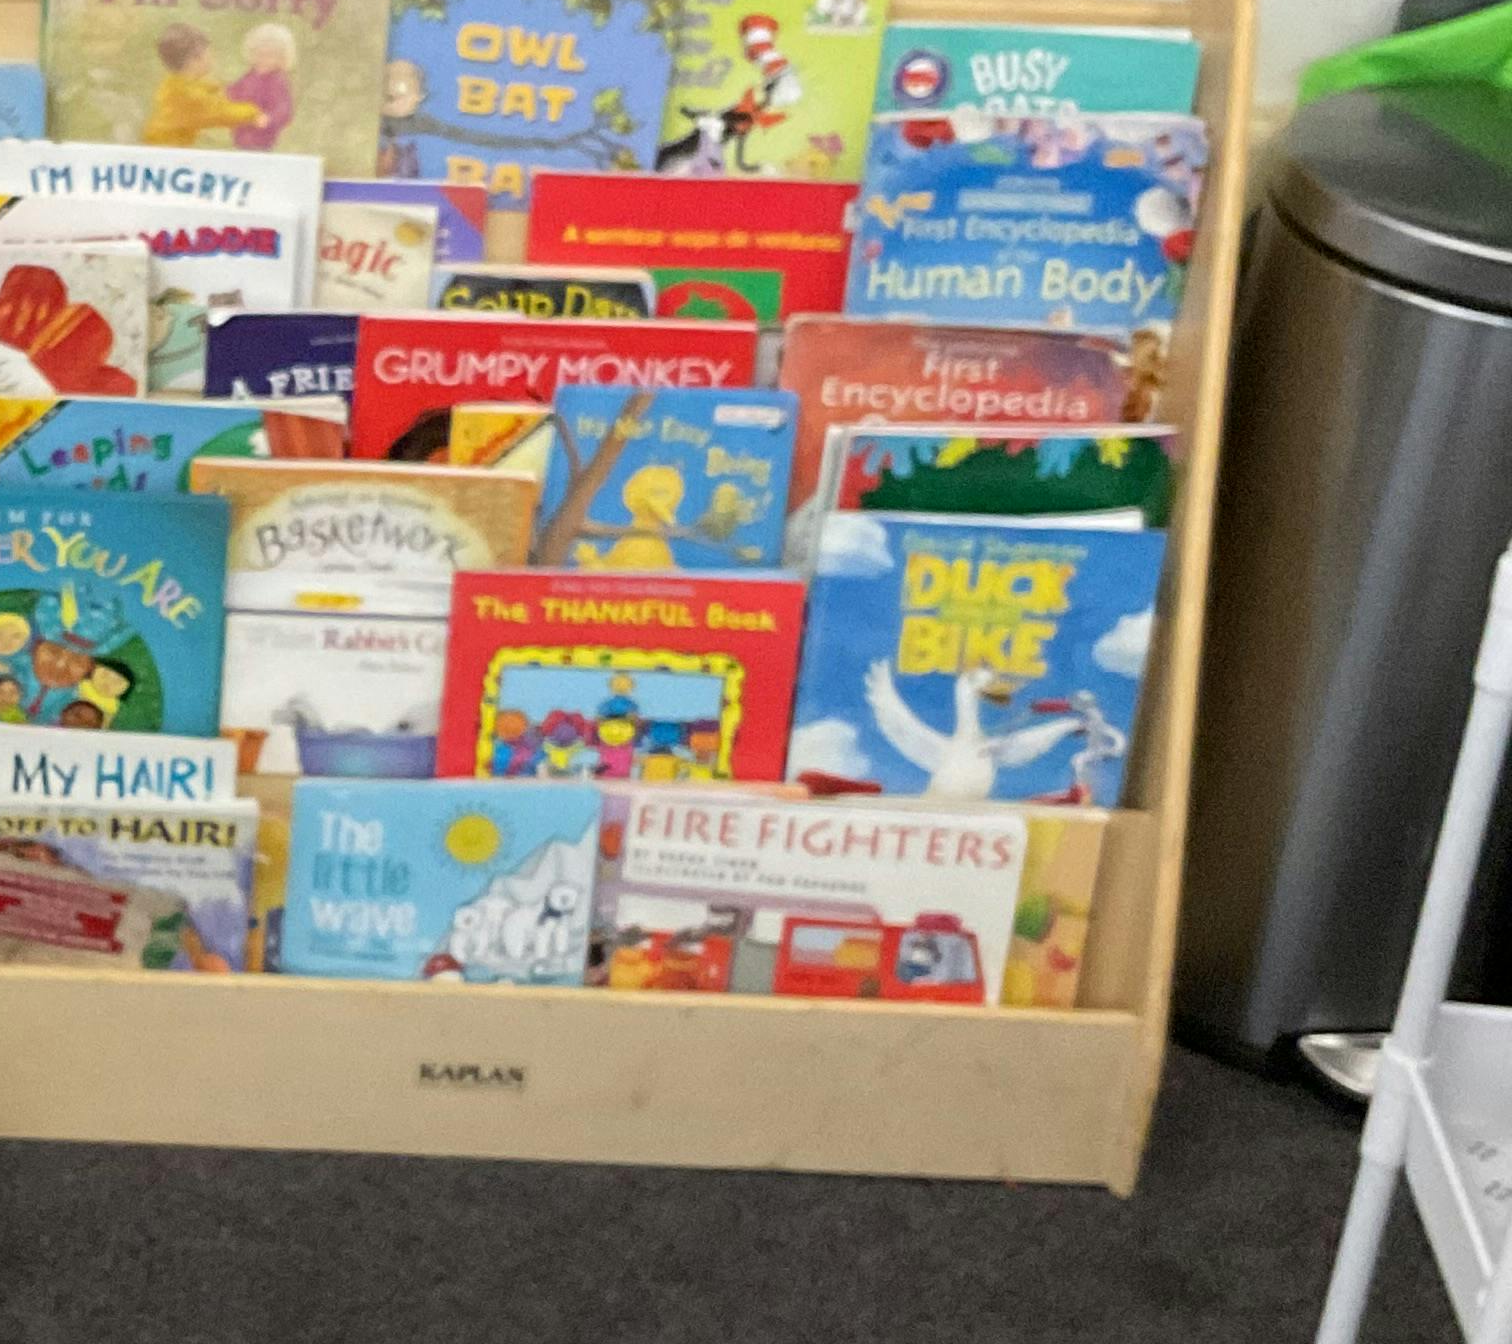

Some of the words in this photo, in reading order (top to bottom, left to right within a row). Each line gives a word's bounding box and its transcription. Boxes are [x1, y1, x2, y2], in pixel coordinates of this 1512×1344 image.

[456, 22, 586, 73] OWL
[970, 47, 1071, 96] BUSY
[456, 74, 578, 122] BAT
[30, 164, 72, 194] I'M
[91, 163, 252, 207] HUNGRY!
[319, 233, 402, 279] agic
[867, 261, 1022, 301] Human
[1041, 258, 1165, 317] Body
[267, 364, 354, 399] FRIE
[373, 348, 548, 387] GRUMPY
[555, 354, 733, 389] MONKEY
[921, 355, 1001, 384] First
[820, 375, 1088, 420] Encyclopedia
[41, 526, 128, 577] YOU
[118, 560, 204, 630] ARE
[905, 552, 1076, 614] DUCK
[473, 595, 529, 624] The
[541, 598, 696, 628] THANKFUL
[897, 617, 1058, 677] BIKE
[95, 753, 215, 800] HAIR!
[60, 816, 98, 836] TO
[109, 816, 237, 848] HAIR!
[320, 810, 384, 854] The
[637, 804, 741, 848] FIRE
[758, 813, 1013, 871] FIGHTERS
[418, 1063, 525, 1090] KAPLAN
